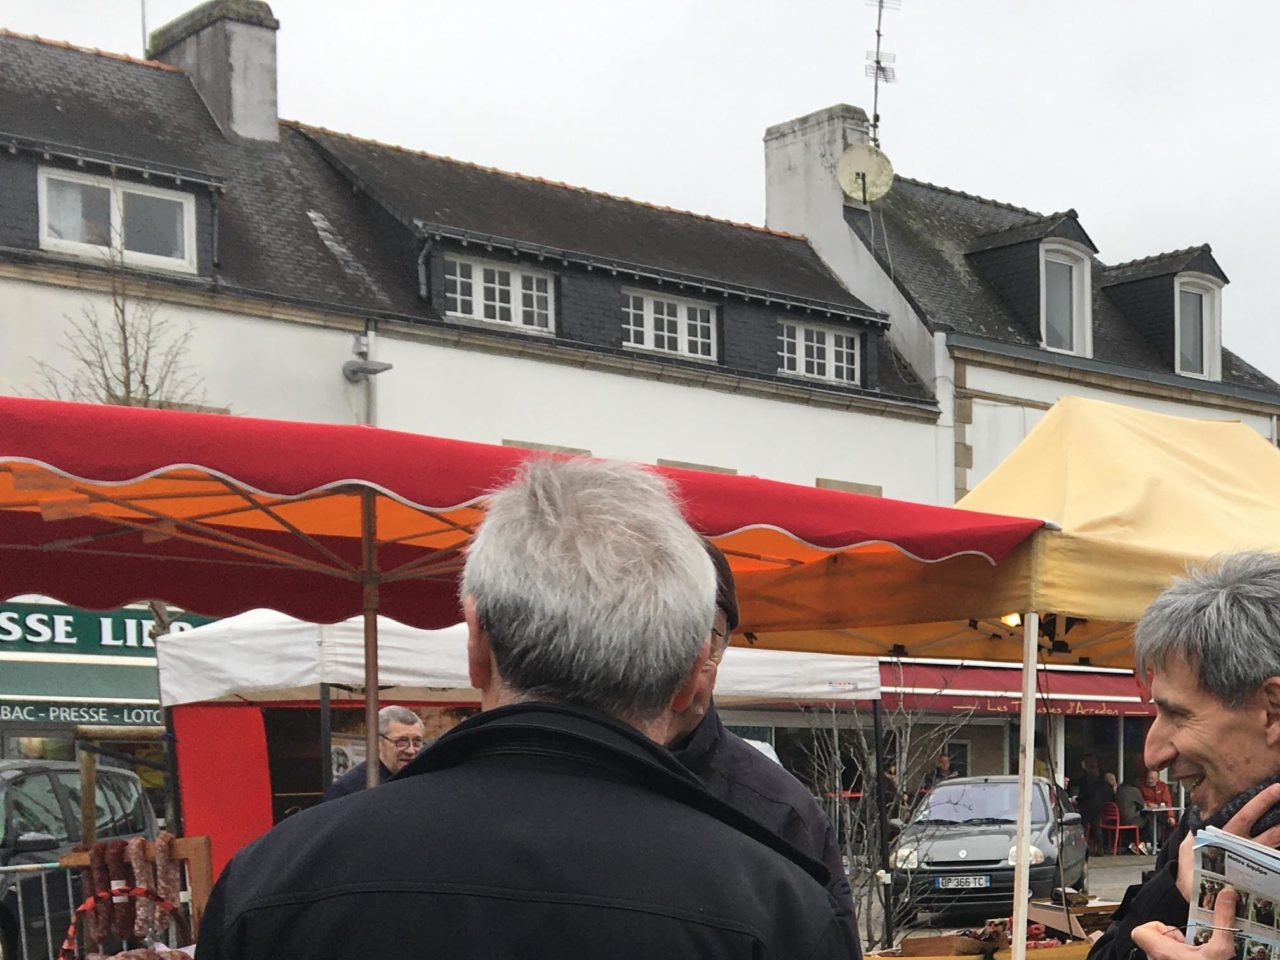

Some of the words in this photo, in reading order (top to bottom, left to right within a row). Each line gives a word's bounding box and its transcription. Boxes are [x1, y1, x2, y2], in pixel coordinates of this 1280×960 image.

[987, 699, 1008, 712] Les
[50, 706, 109, 722] PRESSE
[954, 877, 971, 887] 366
[972, 877, 984, 887] TC
